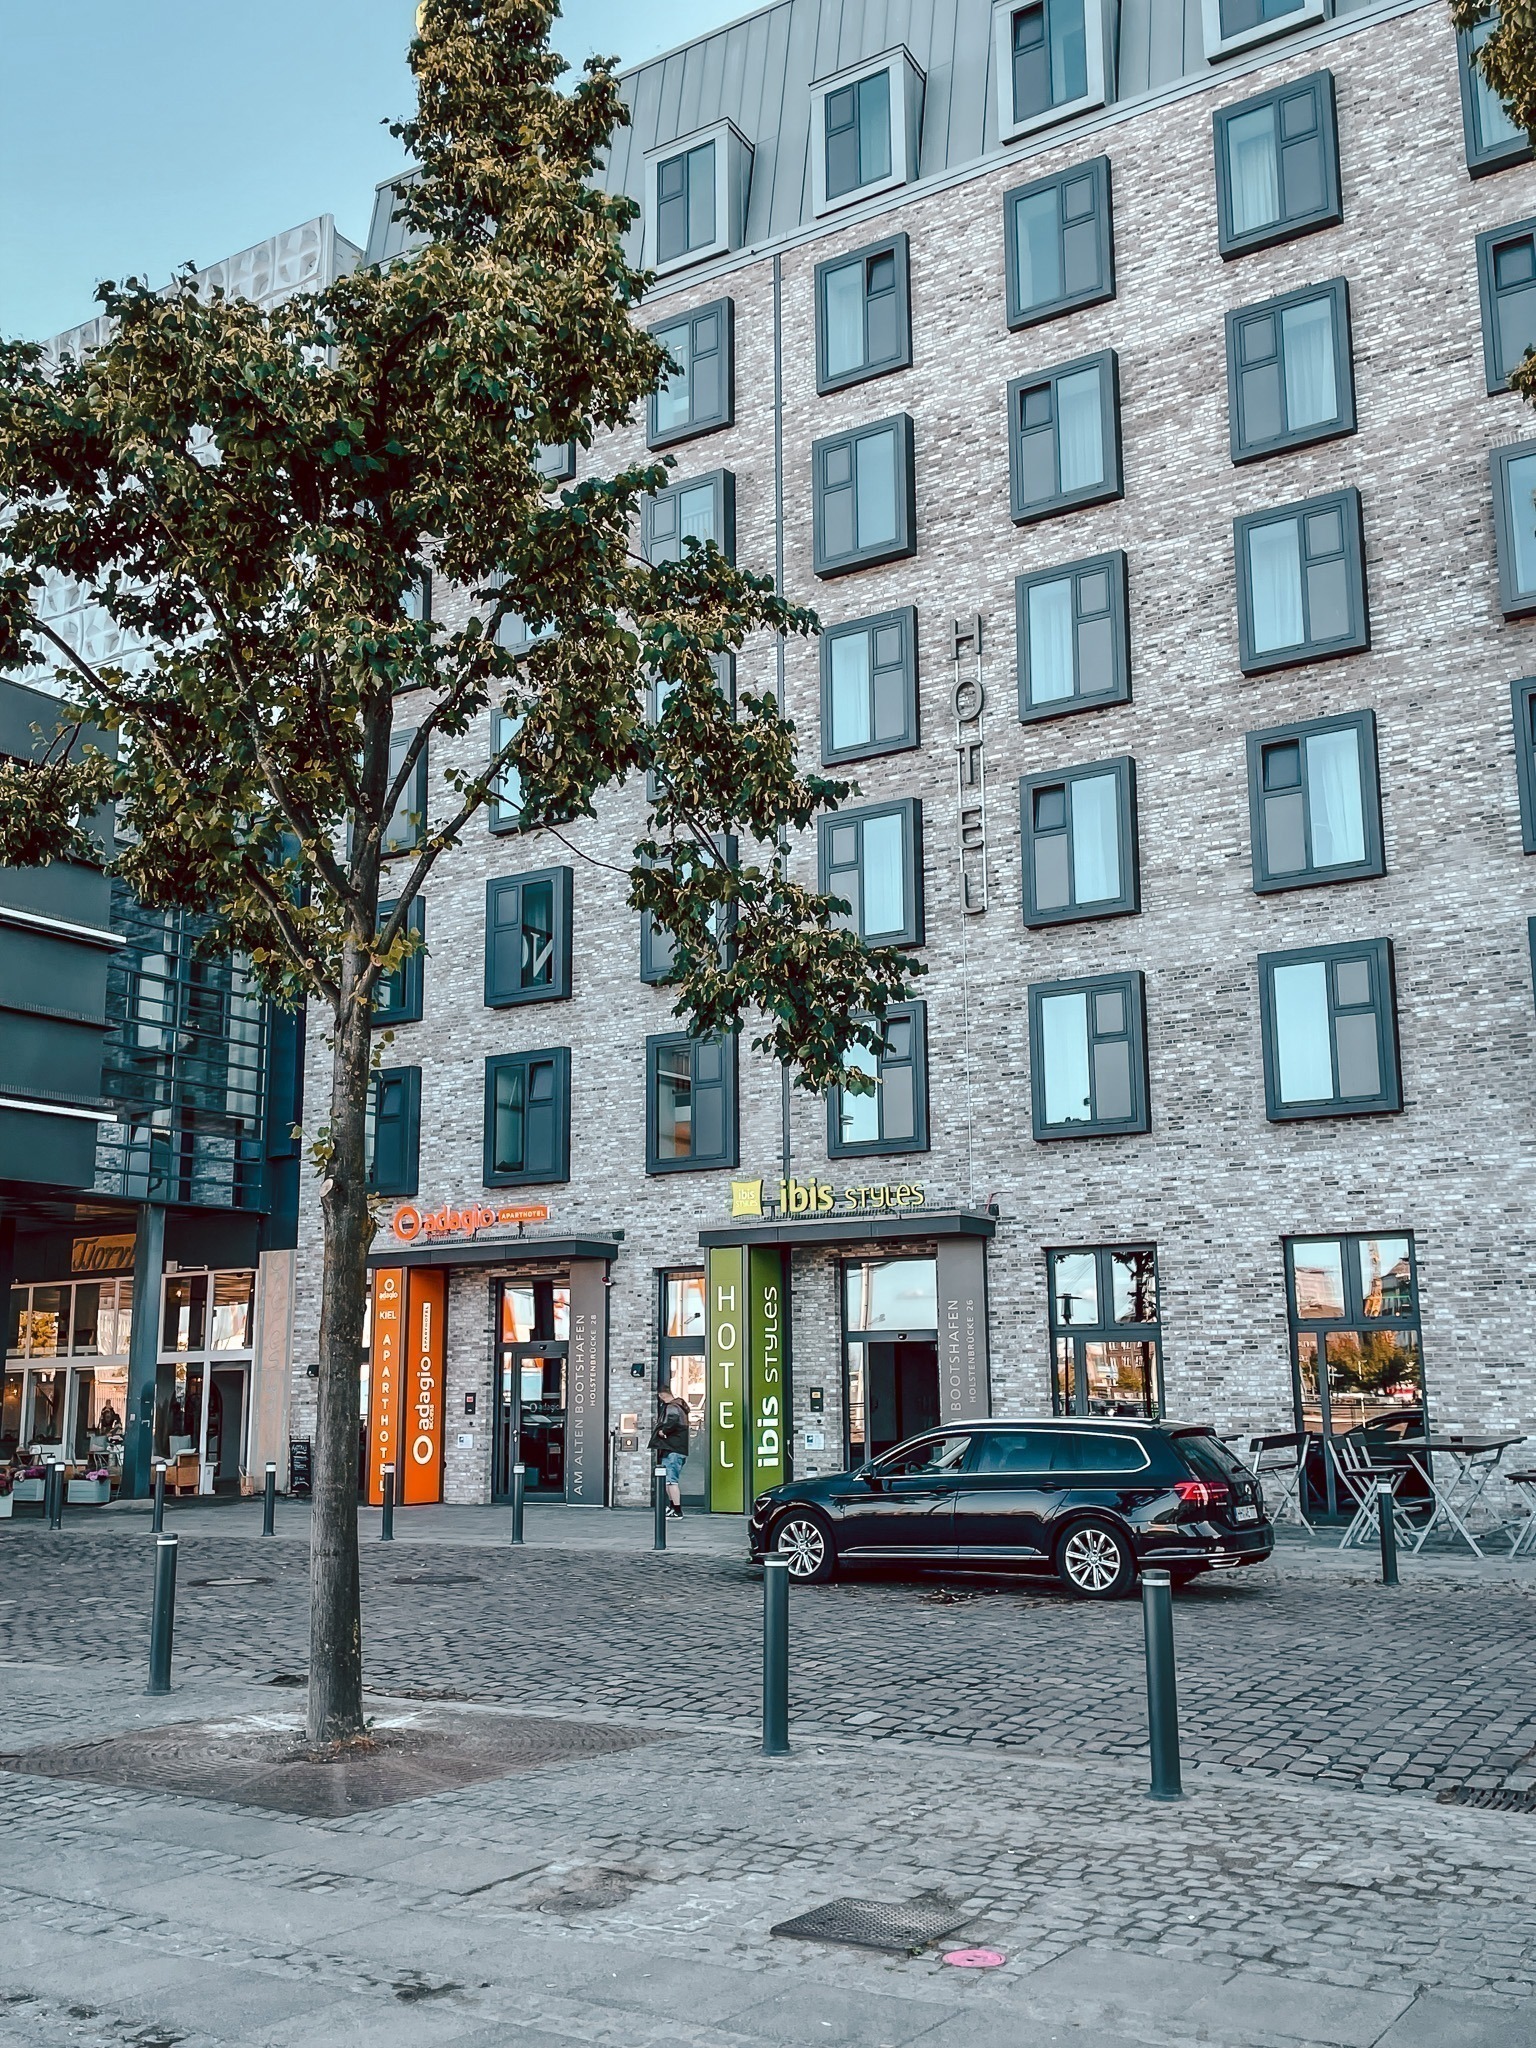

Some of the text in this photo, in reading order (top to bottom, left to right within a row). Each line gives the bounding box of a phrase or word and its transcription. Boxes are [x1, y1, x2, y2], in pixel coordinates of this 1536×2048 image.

[950, 613, 985, 915] HOTEL
[423, 1203, 496, 1237] adagio
[501, 1209, 545, 1219] APARTHOTEL
[780, 1178, 834, 1213] ibis
[379, 1291, 398, 1300] adagio
[379, 1311, 396, 1320] KIEL
[414, 1356, 435, 1431] adagio
[717, 1285, 736, 1468] HOTEL
[947, 1300, 962, 1411] BOOTSHAFEN
[966, 1299, 977, 1403] HOLSTENBRÜCKE 26
[379, 1334, 391, 1492] APARTHOTEL
[574, 1314, 585, 1496] AM ALTEN BOOTSHAFEN
[757, 1395, 779, 1468] ibis
